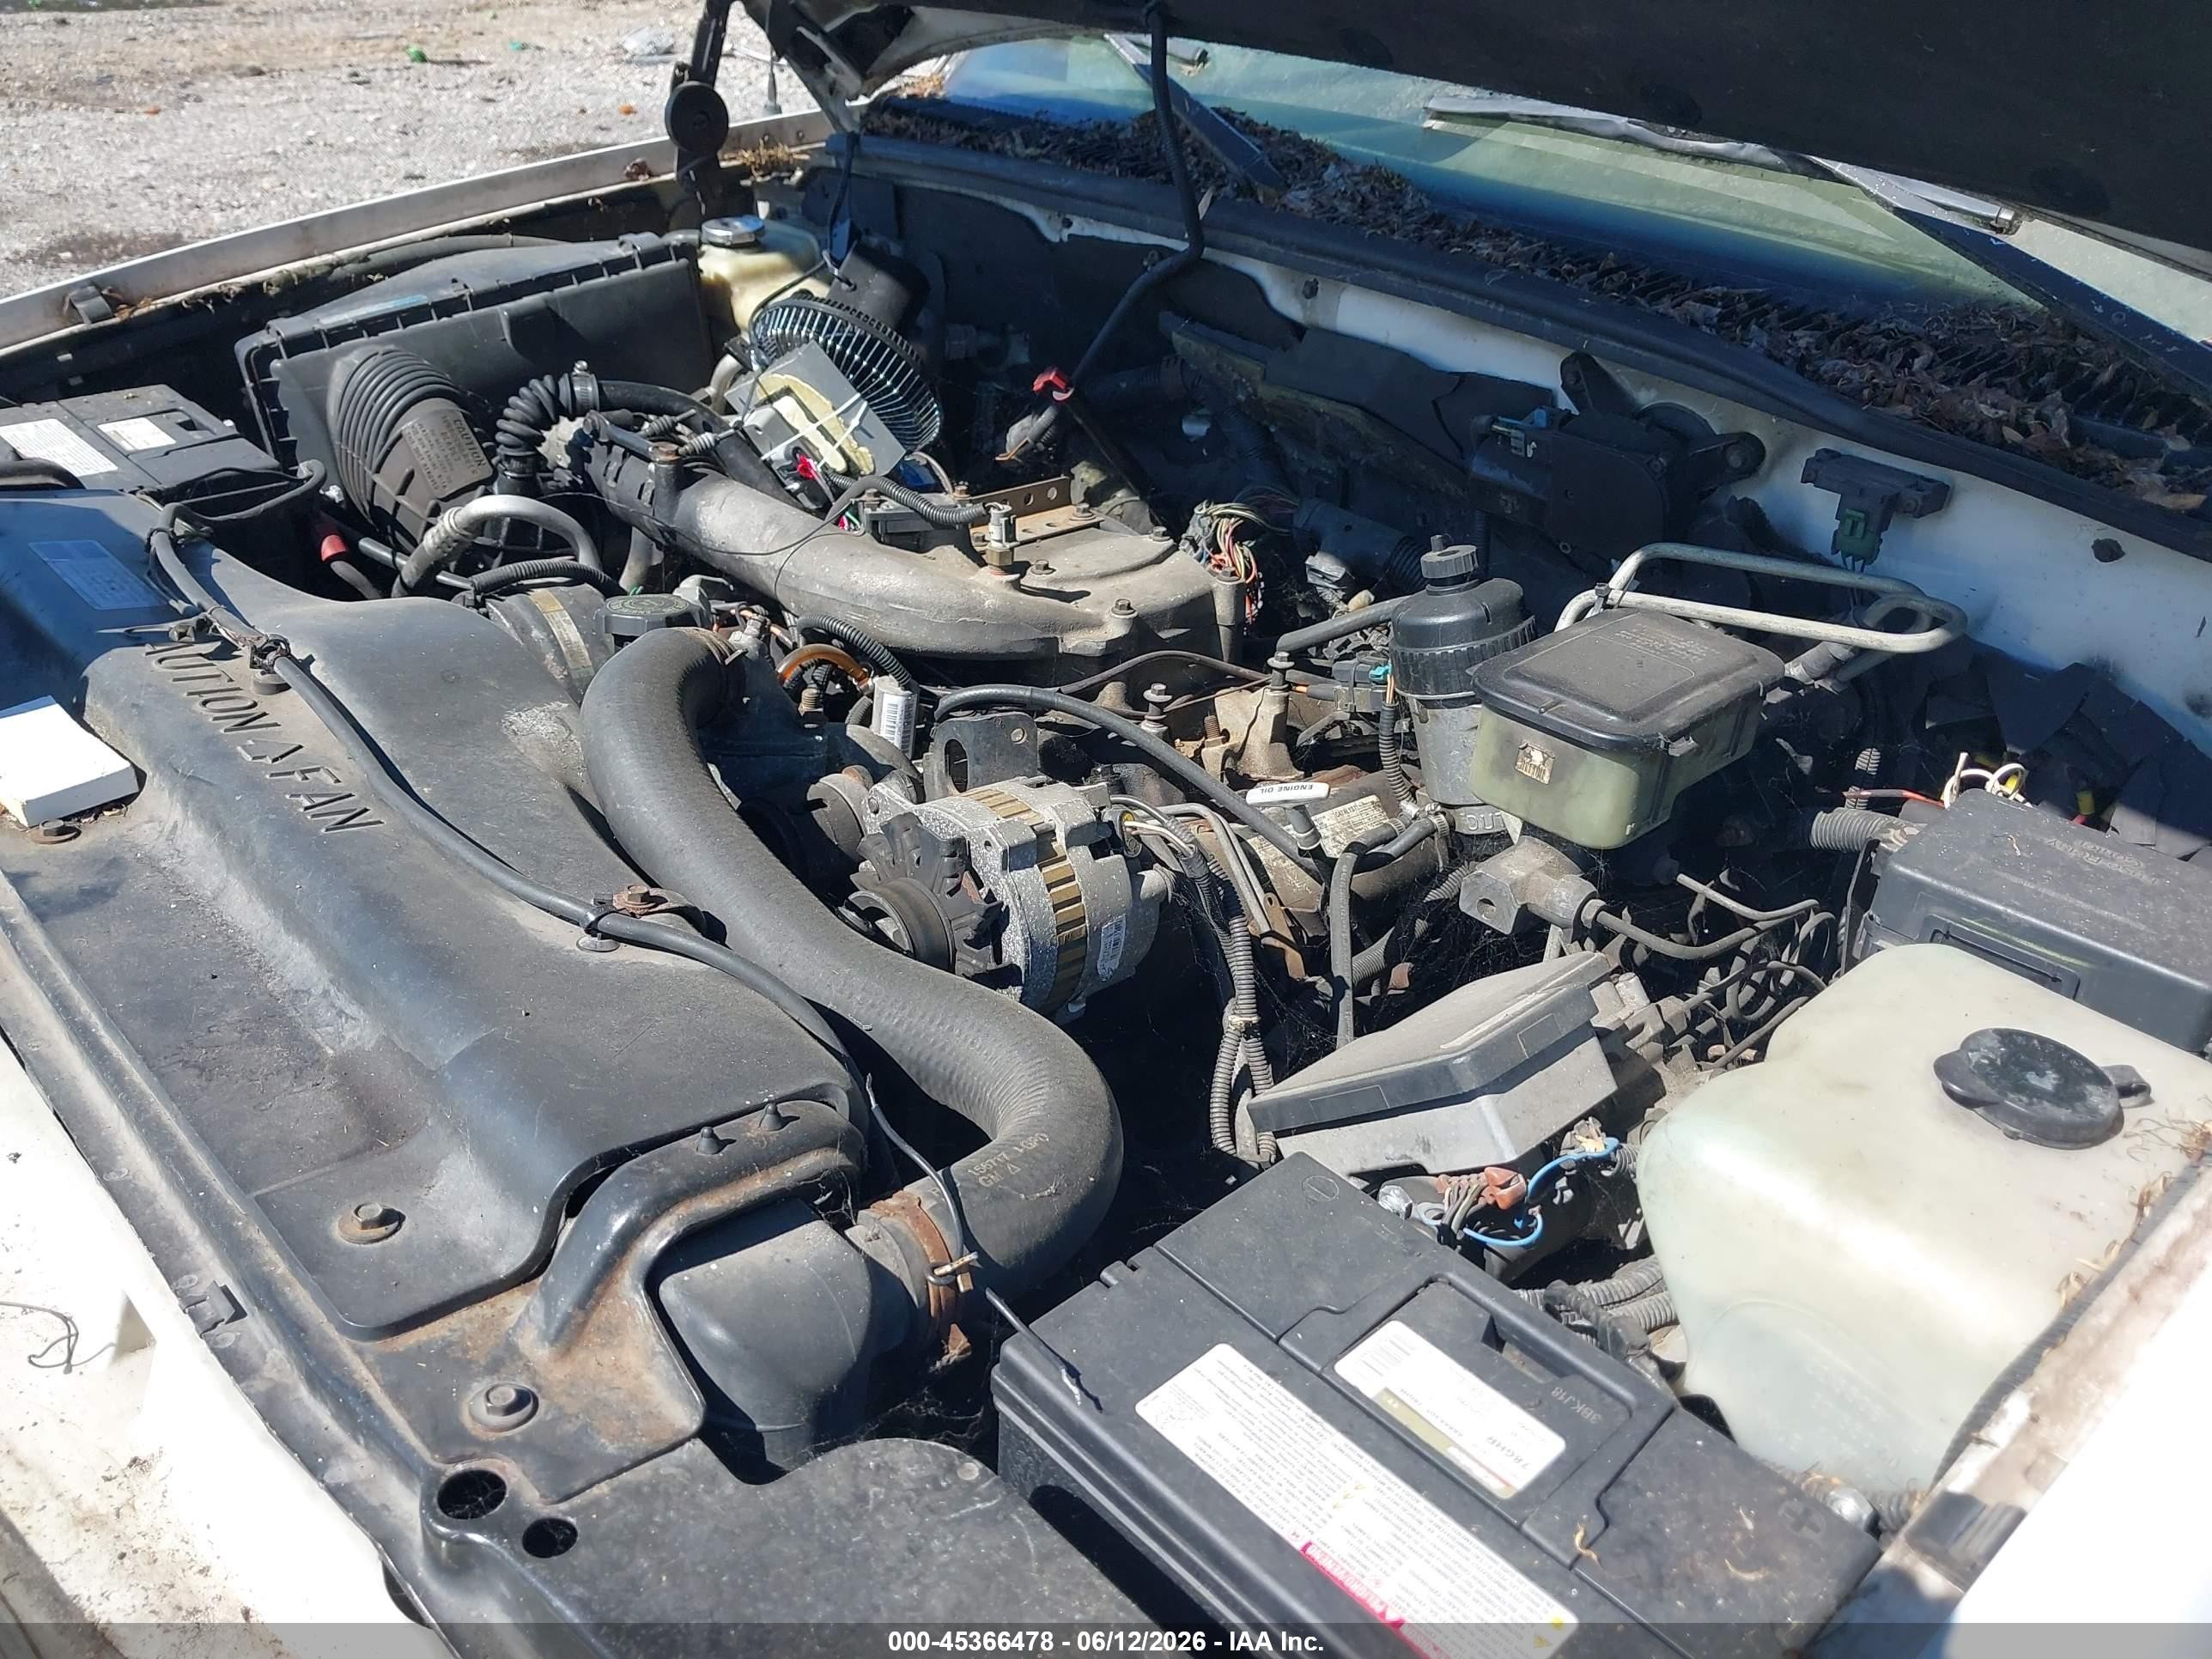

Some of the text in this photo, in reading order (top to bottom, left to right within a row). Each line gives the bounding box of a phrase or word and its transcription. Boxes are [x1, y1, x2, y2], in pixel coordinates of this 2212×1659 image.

[453, 419, 487, 467] CAUTION
[265, 766, 385, 833] FAN
[1277, 783, 1314, 793] ENGINE
